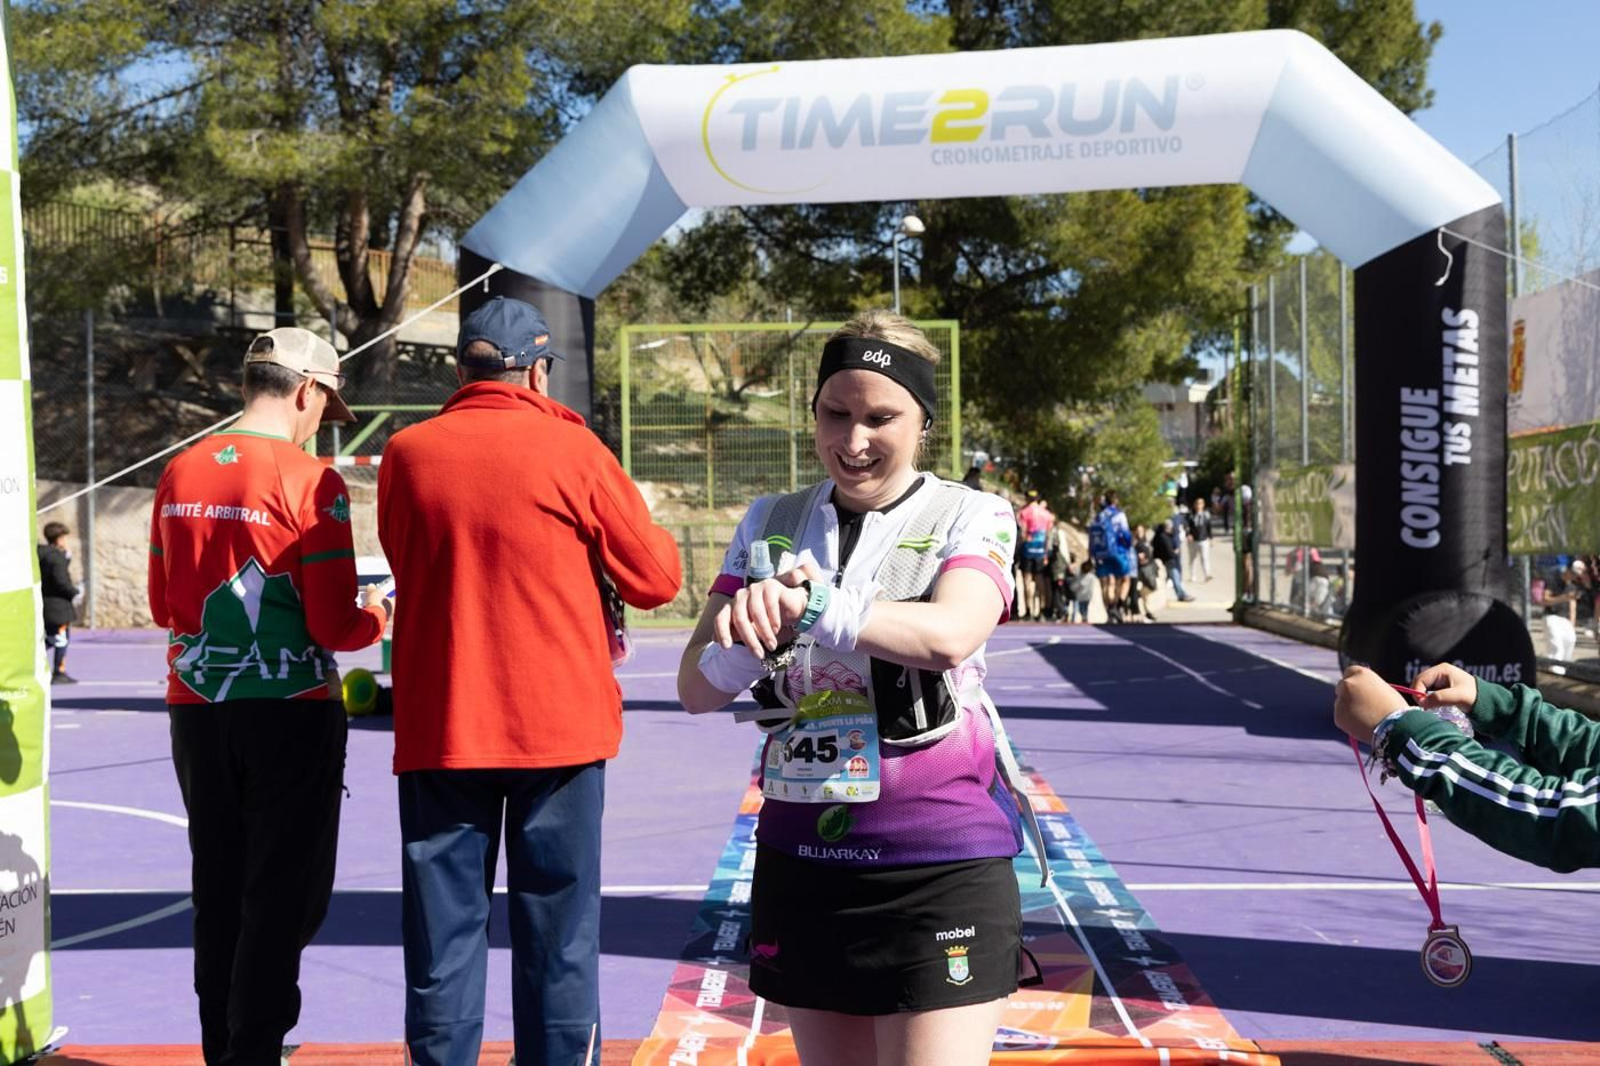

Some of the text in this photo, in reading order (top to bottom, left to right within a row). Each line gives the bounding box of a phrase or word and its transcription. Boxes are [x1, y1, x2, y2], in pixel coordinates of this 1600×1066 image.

[729, 75, 1180, 151] TIME2RUN
[931, 135, 1182, 165] CRONOMETRAJE DEPORTIVO
[862, 349, 891, 368] edp
[1441, 307, 1480, 466] TUS METAS
[1400, 387, 1441, 549] CONSIGUE
[161, 502, 271, 526] COMITÉ ARBITRAL
[798, 845, 882, 860] BUJARKAY
[935, 925, 975, 941] mobel
